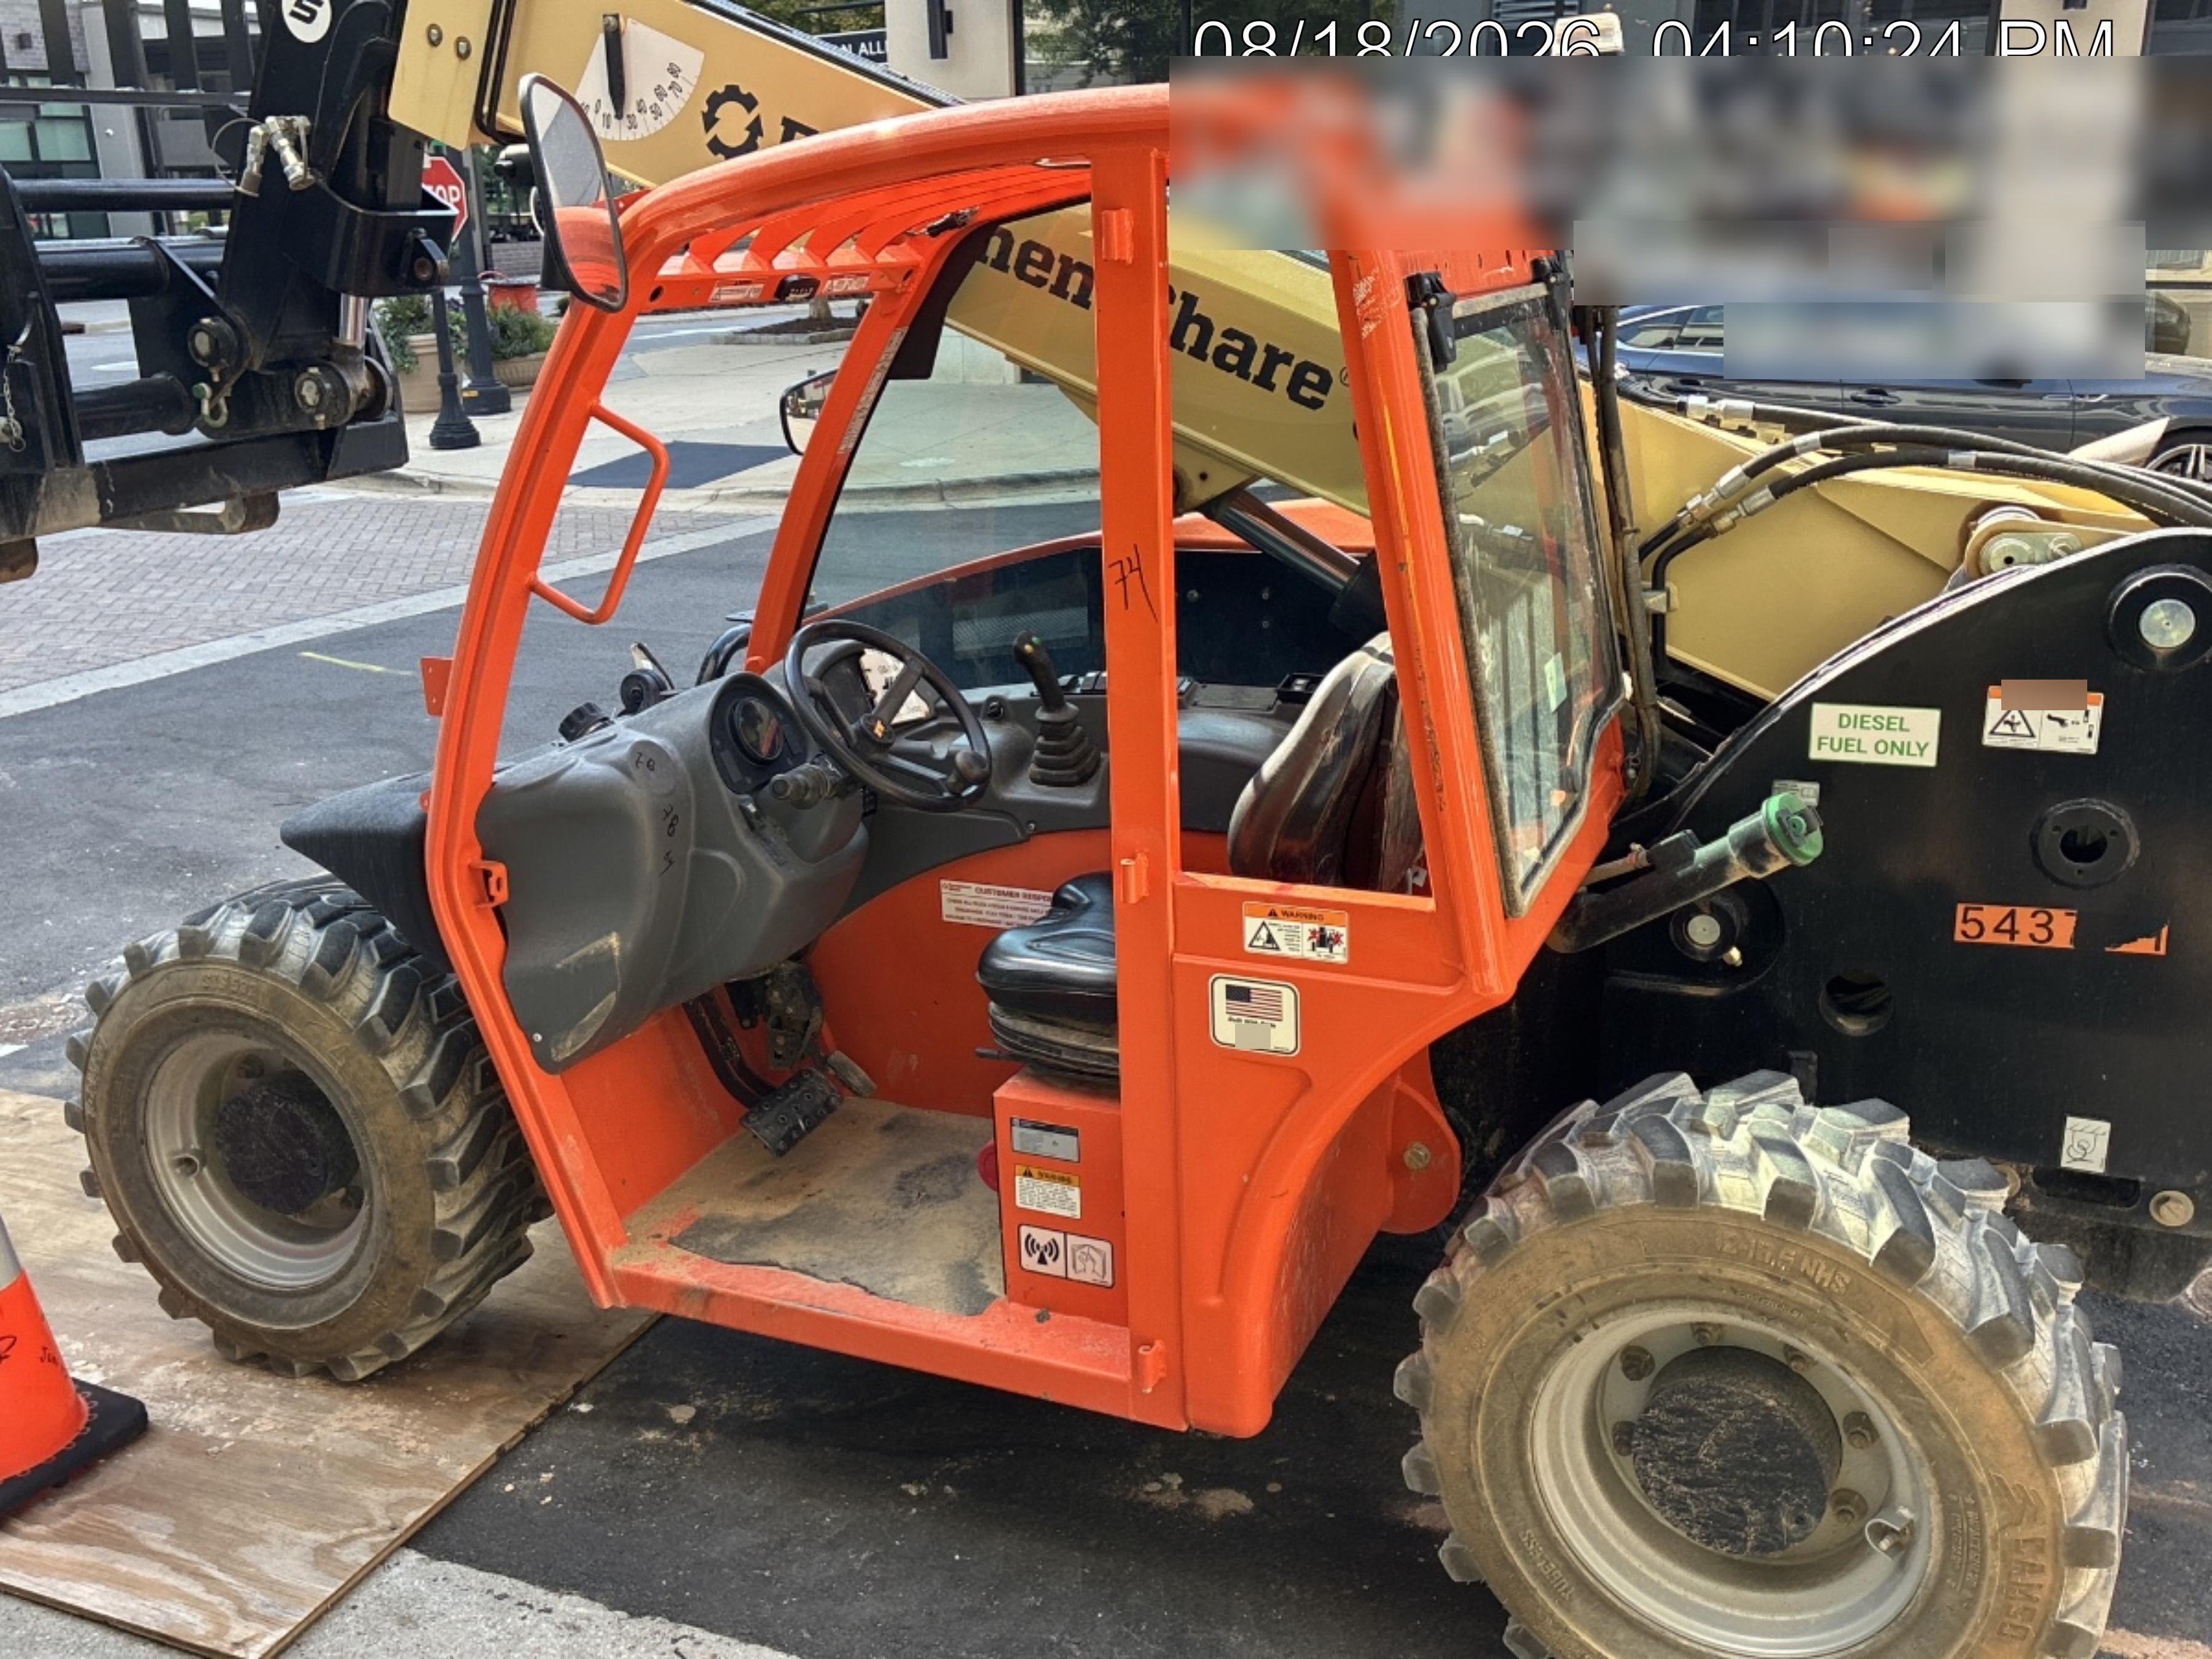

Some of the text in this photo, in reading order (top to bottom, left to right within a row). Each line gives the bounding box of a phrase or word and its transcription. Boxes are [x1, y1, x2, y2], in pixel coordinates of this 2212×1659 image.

[859, 40, 888, 57] ALL
[636, 98, 648, 114] 40
[649, 102, 663, 120] 50
[602, 112, 611, 130] 10
[626, 113, 638, 130] 30
[1108, 544, 1158, 623] 74
[1838, 712, 1910, 733] DIESEL
[1816, 735, 1930, 759] FUEL ONLY
[975, 887, 1021, 899] CUSTOMER
[1022, 891, 1053, 903] RESPO
[1281, 909, 1324, 921] WARNING
[1800, 1252, 1851, 1293] NHS
